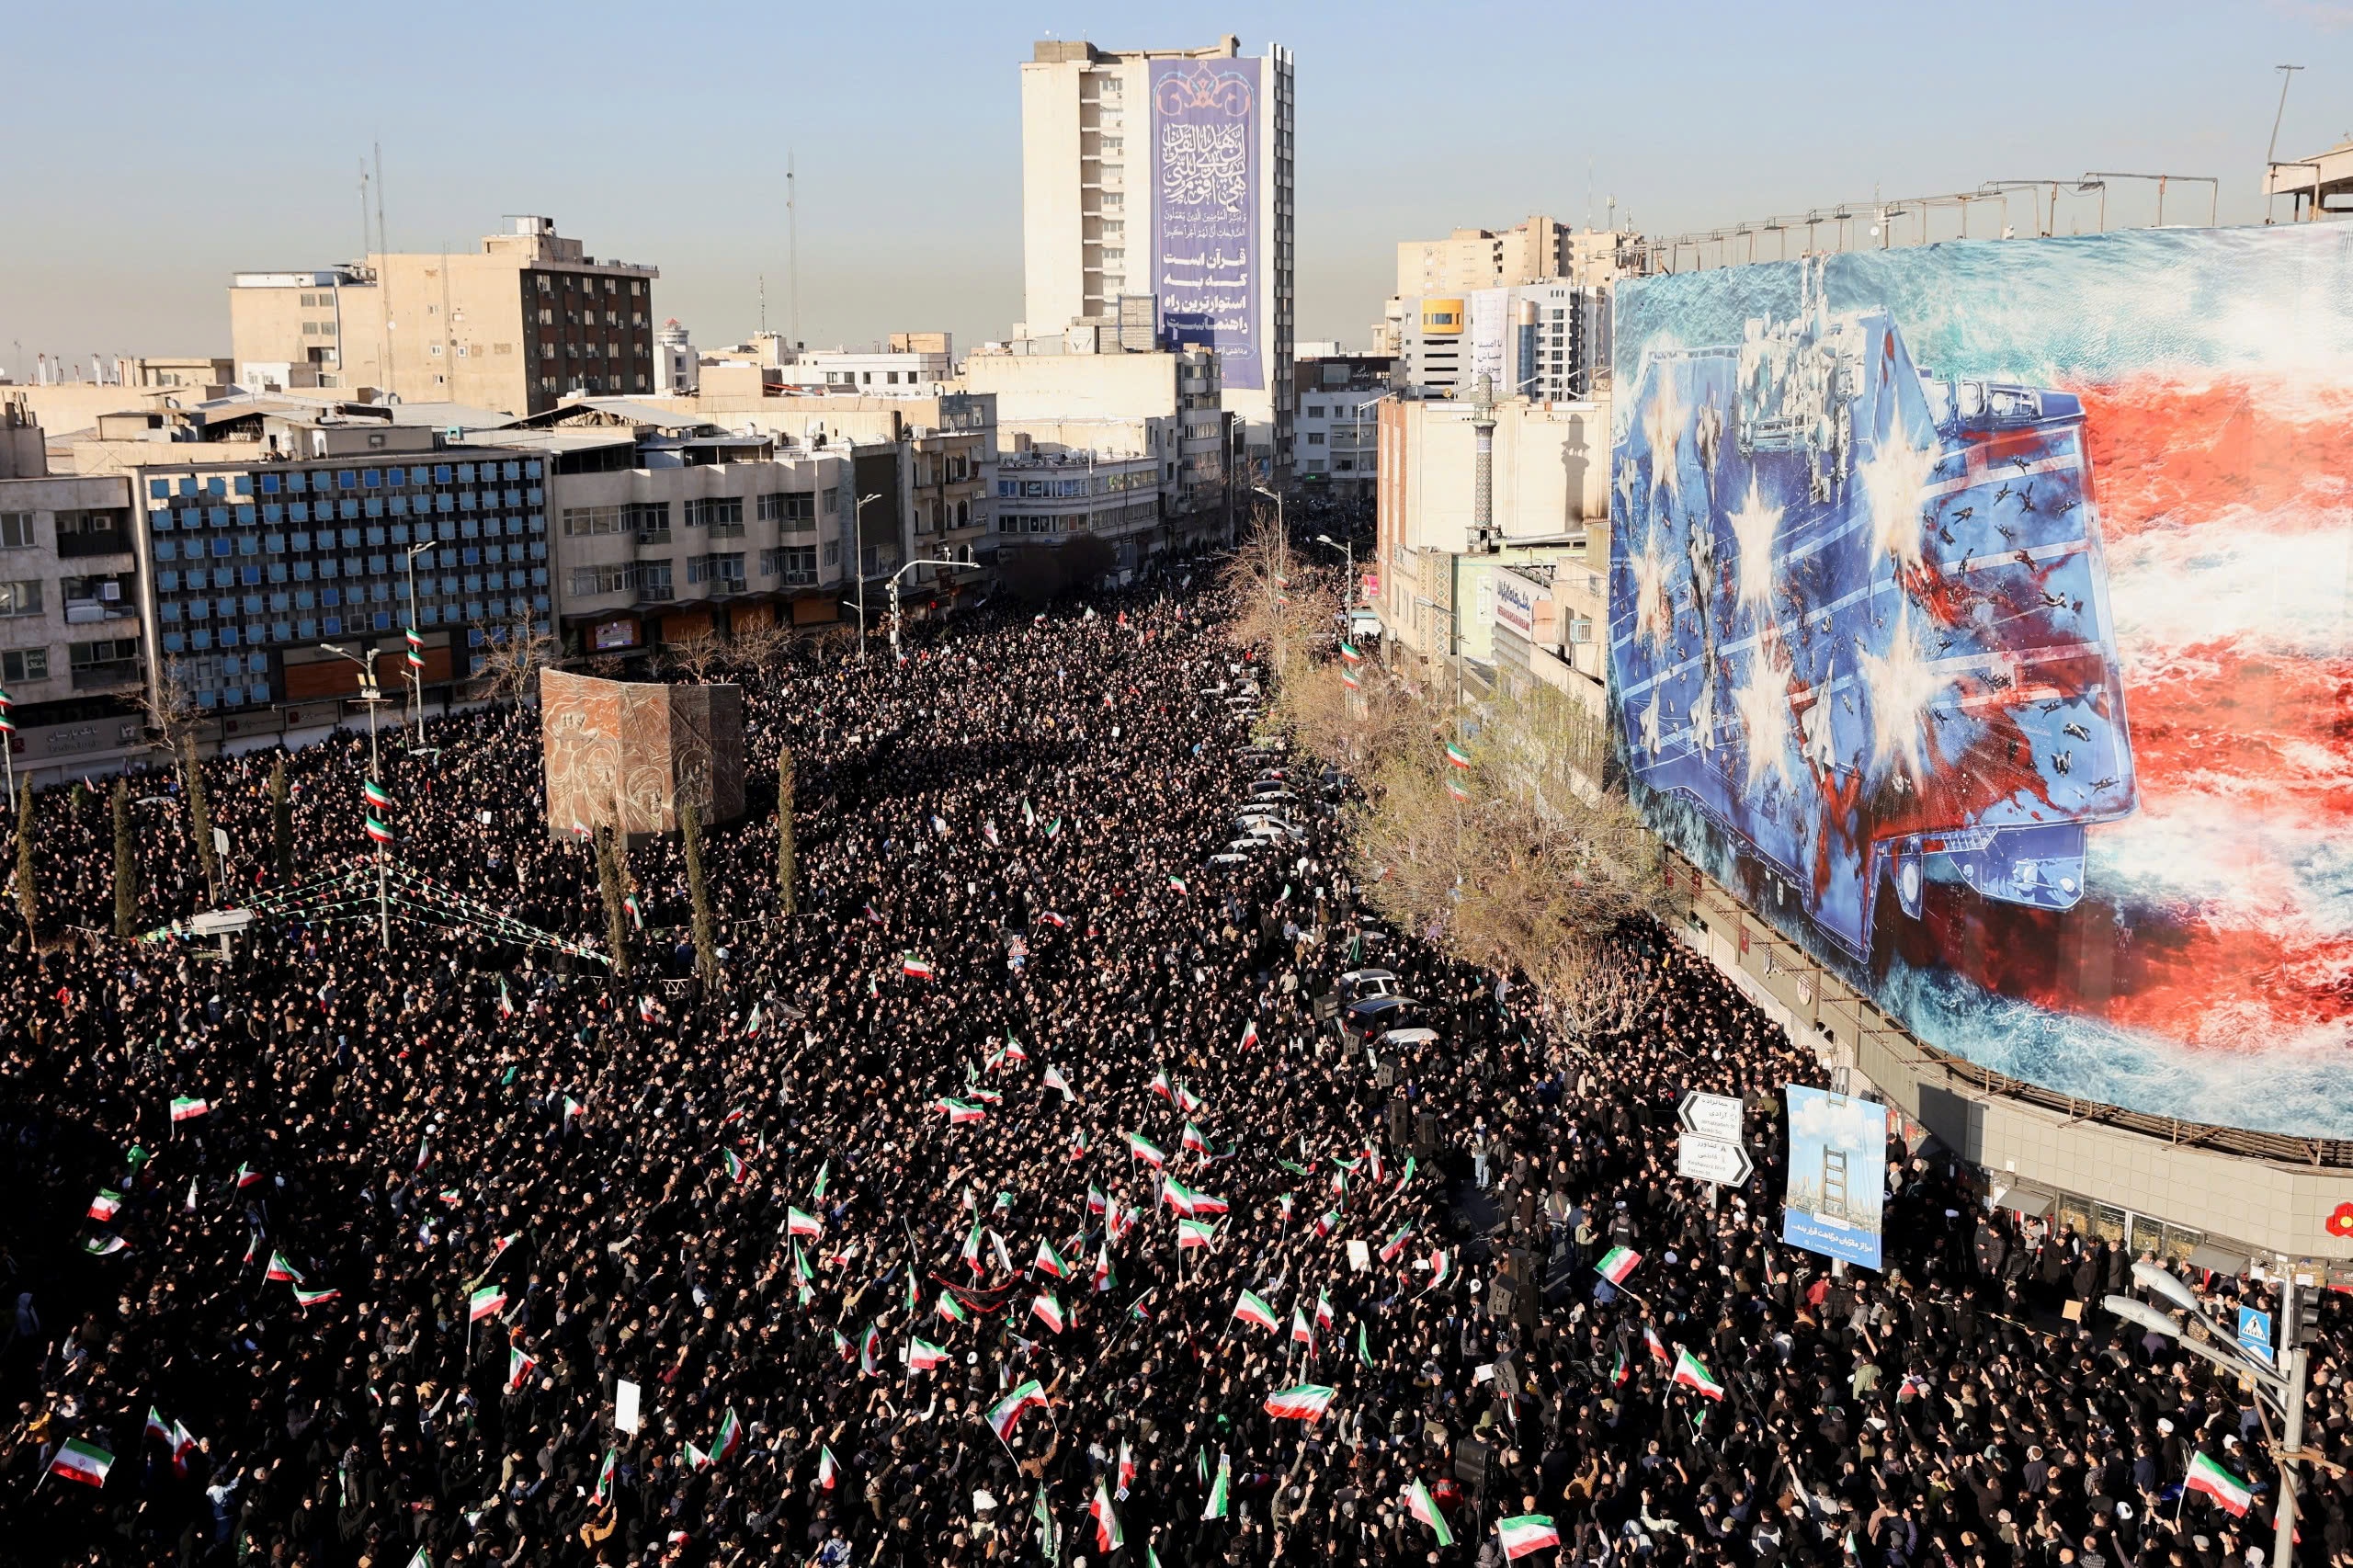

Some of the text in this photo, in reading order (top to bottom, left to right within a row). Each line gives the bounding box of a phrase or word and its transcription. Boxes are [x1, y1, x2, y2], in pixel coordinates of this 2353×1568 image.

[1163, 247, 1246, 269] قرآن است
[1163, 272, 1247, 290] که به
[1164, 293, 1246, 313] استوارترین راه
[1709, 1110, 1728, 1119] آزادی
[1697, 1141, 1718, 1149] کشاورز
